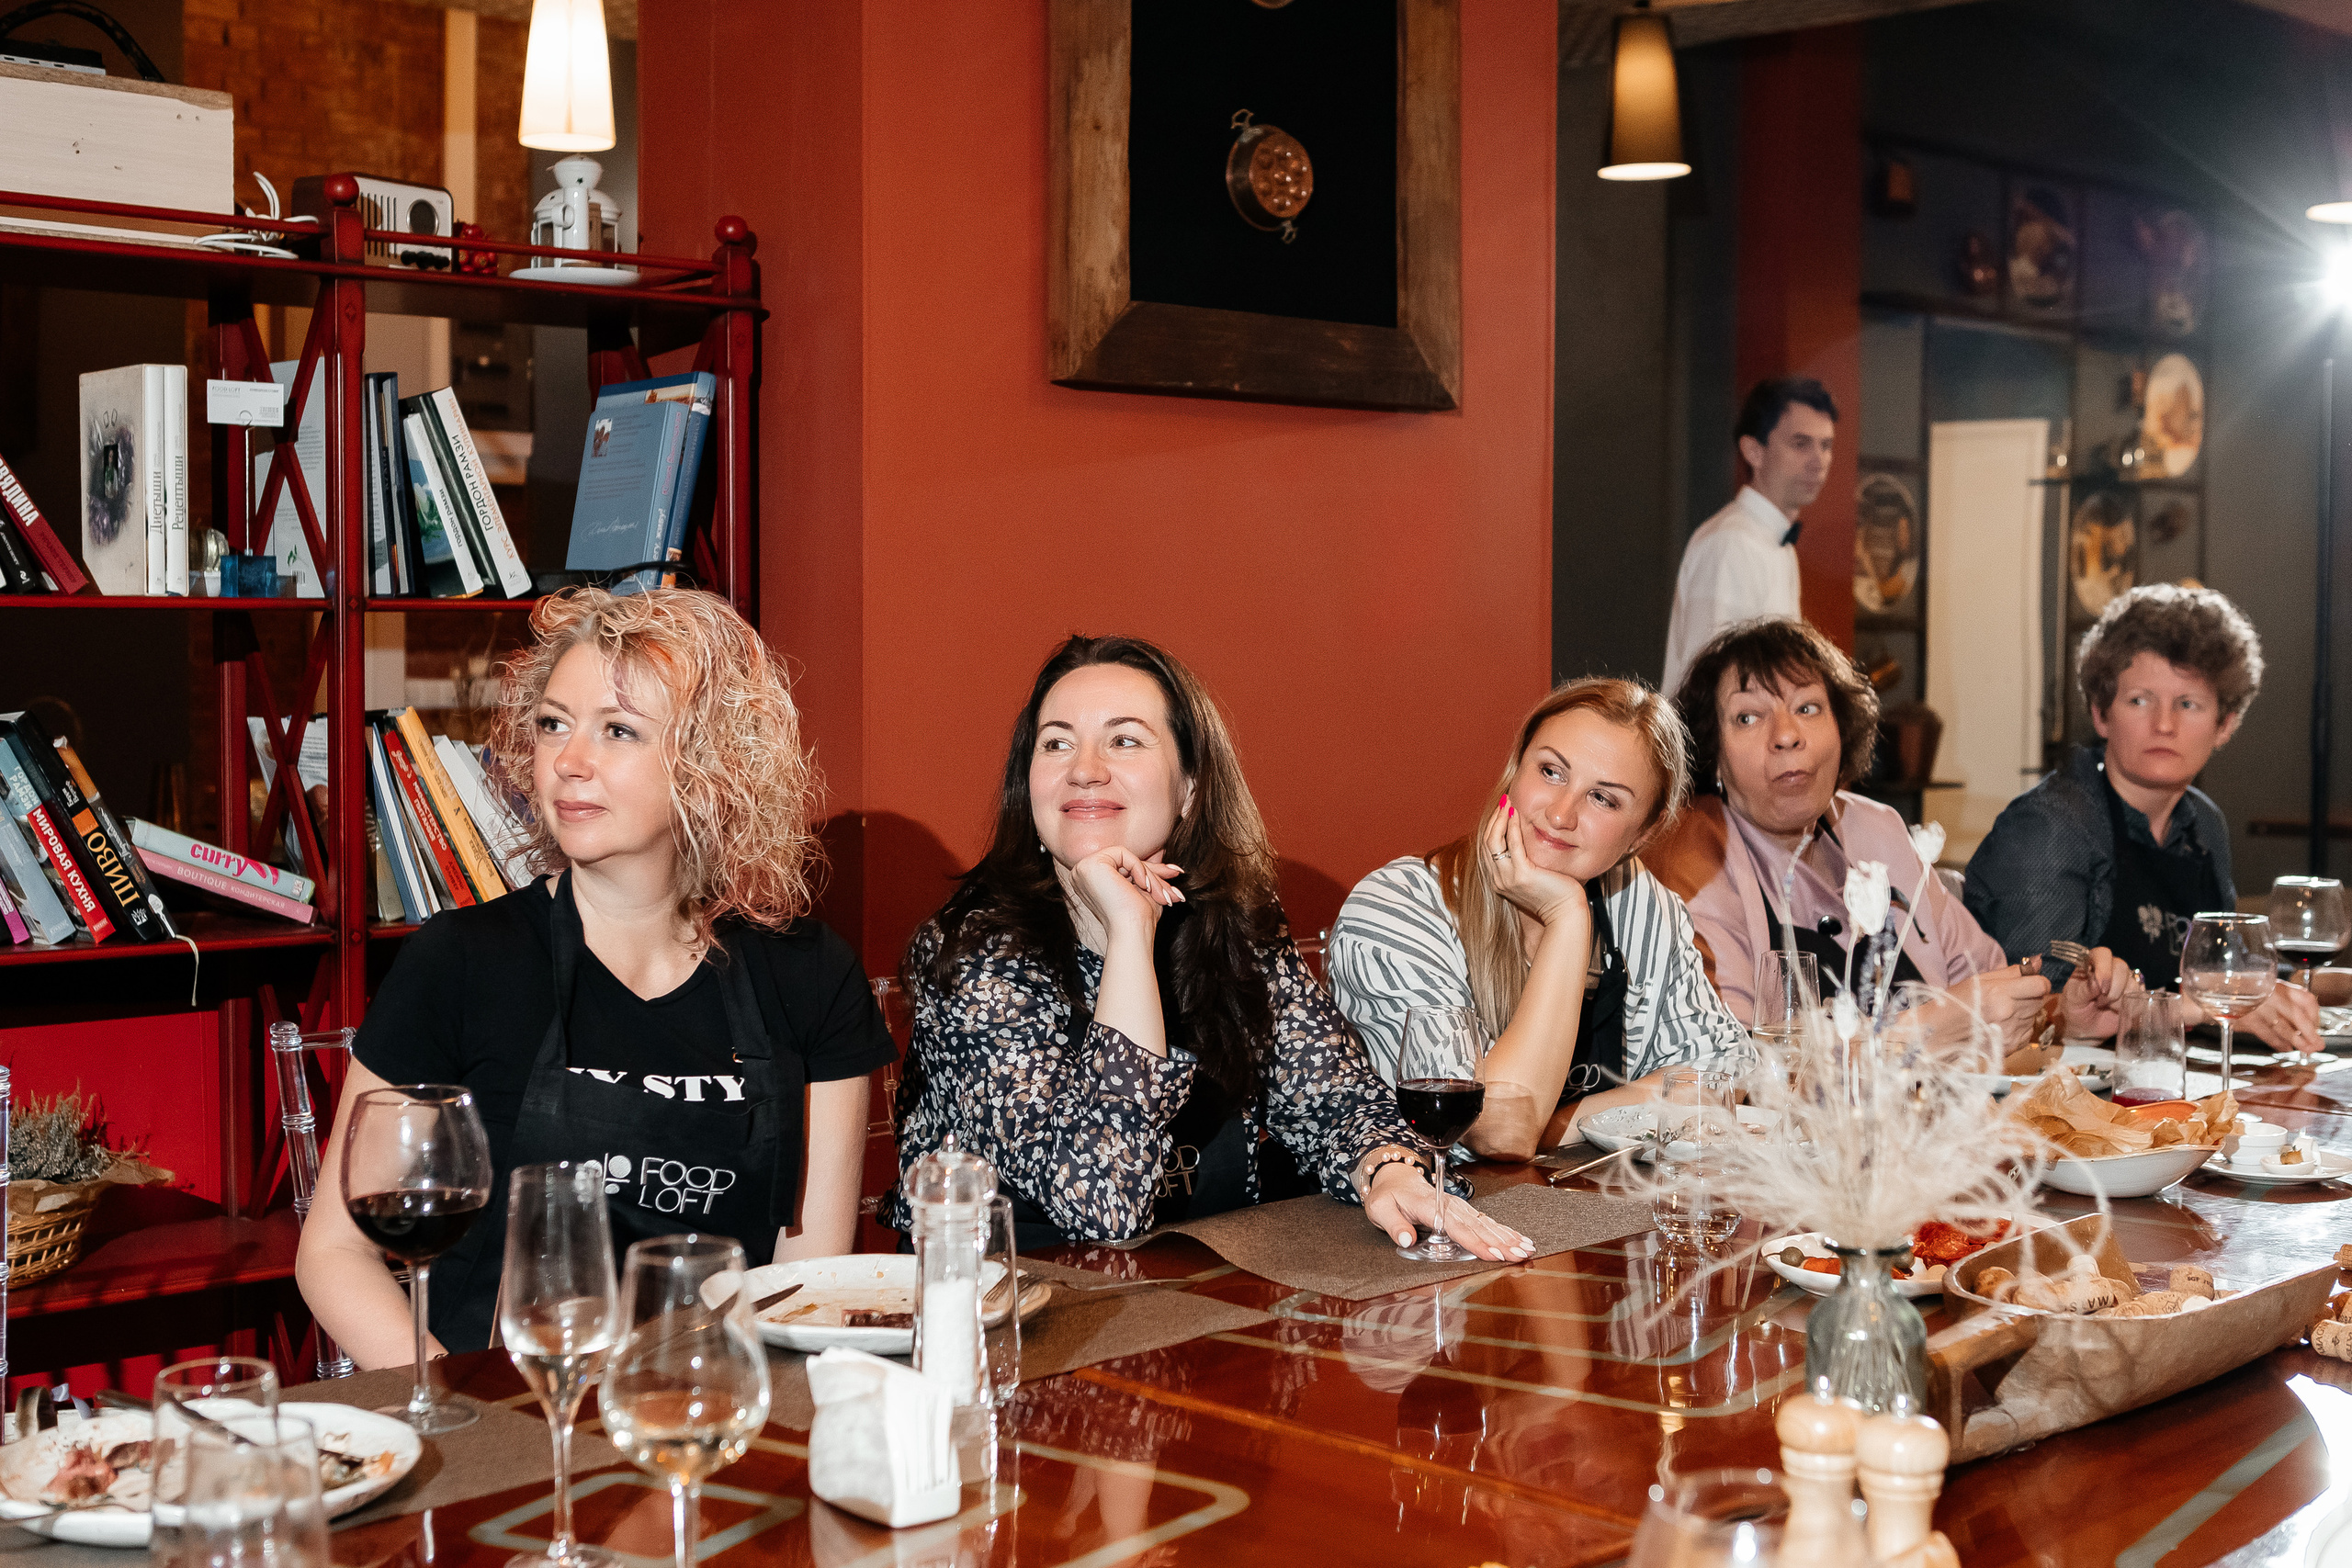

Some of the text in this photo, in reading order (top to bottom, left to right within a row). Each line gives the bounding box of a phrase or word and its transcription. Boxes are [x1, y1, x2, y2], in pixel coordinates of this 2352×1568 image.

[447, 397, 474, 456] КУЛИНАРИИ
[0, 457, 40, 527] ВЯДИНА
[452, 434, 493, 531] ГОРДОН РАМЗИ
[501, 536, 515, 558] КУРС
[9, 775, 33, 810] РАМЗИ
[14, 766, 40, 806] ГОРДОН
[32, 808, 73, 872] МИРОВАЯ
[67, 871, 96, 913] КУХНЯ
[87, 832, 141, 908] ПИВО
[176, 866, 228, 890] BOUTIQUE
[190, 843, 249, 877] curry
[640, 1156, 736, 1191] FOOD
[638, 1185, 724, 1214] LOFT
